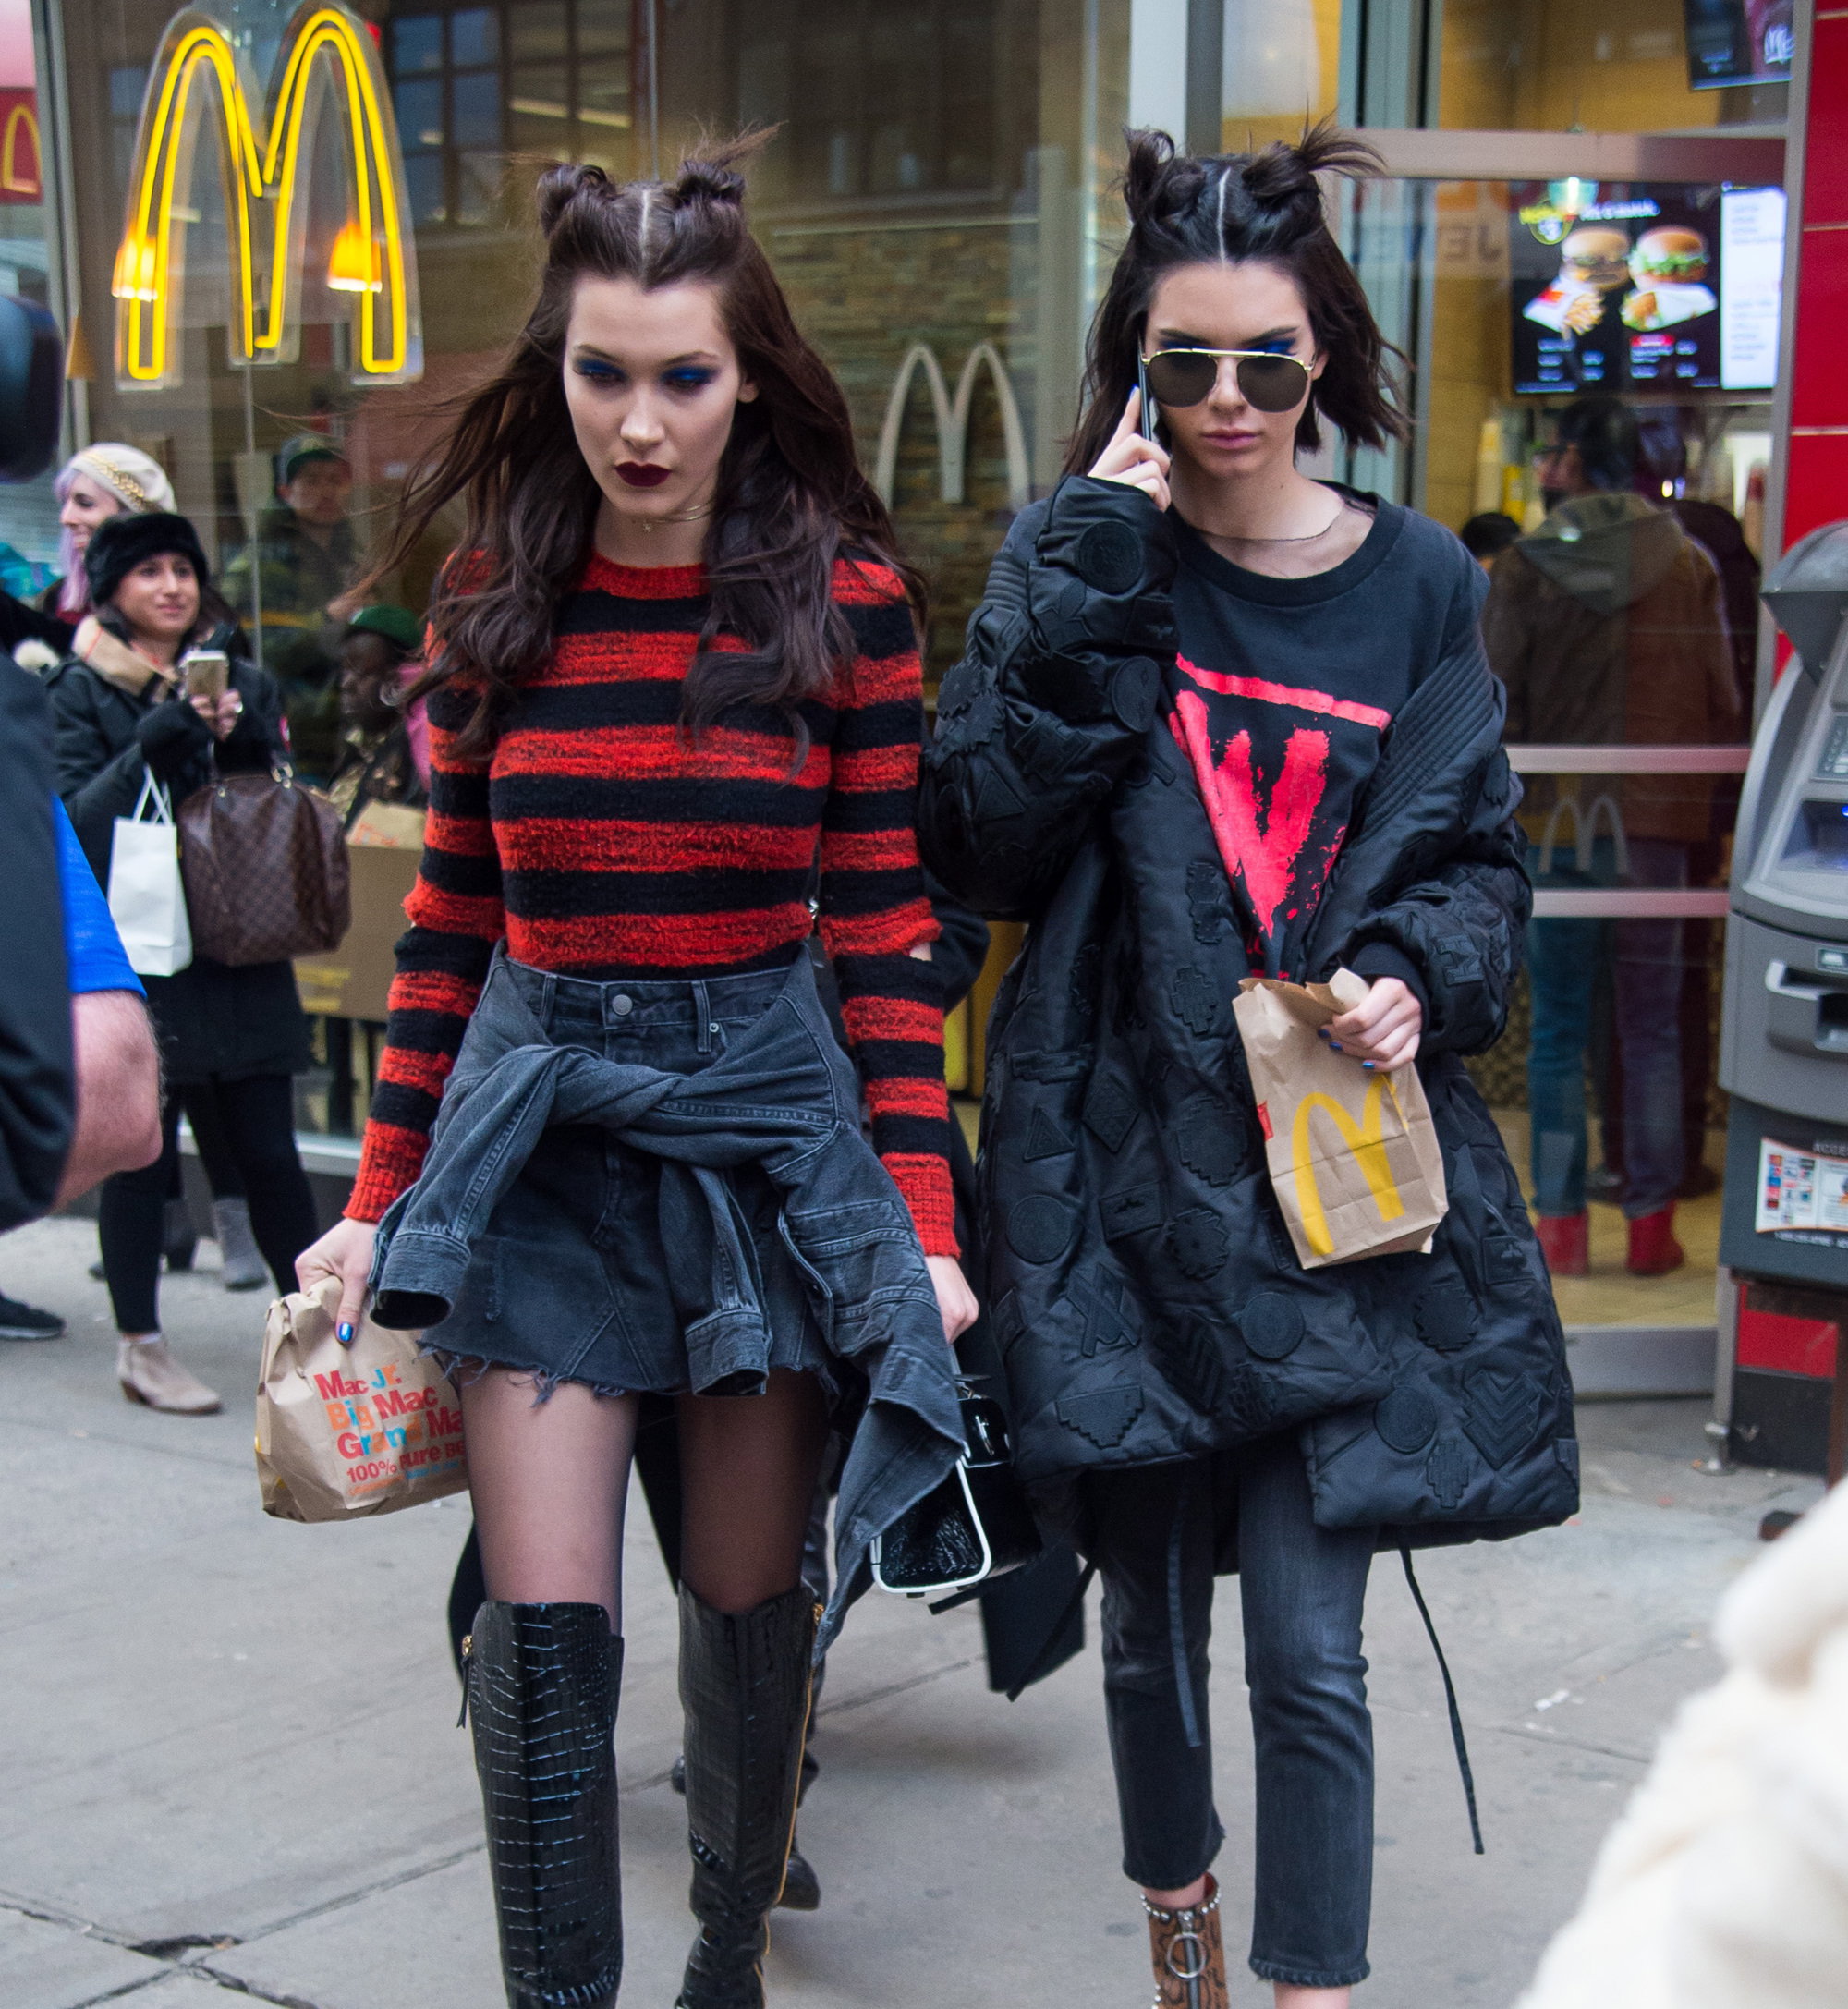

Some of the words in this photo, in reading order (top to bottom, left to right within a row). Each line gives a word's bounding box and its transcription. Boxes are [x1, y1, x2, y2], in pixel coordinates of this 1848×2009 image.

[313, 1370, 369, 1400] Mac
[325, 1399, 375, 1431] Big
[371, 1386, 439, 1420] Mac
[337, 1415, 423, 1459] Grand
[425, 1406, 462, 1439] Ma
[346, 1458, 397, 1483] 100%
